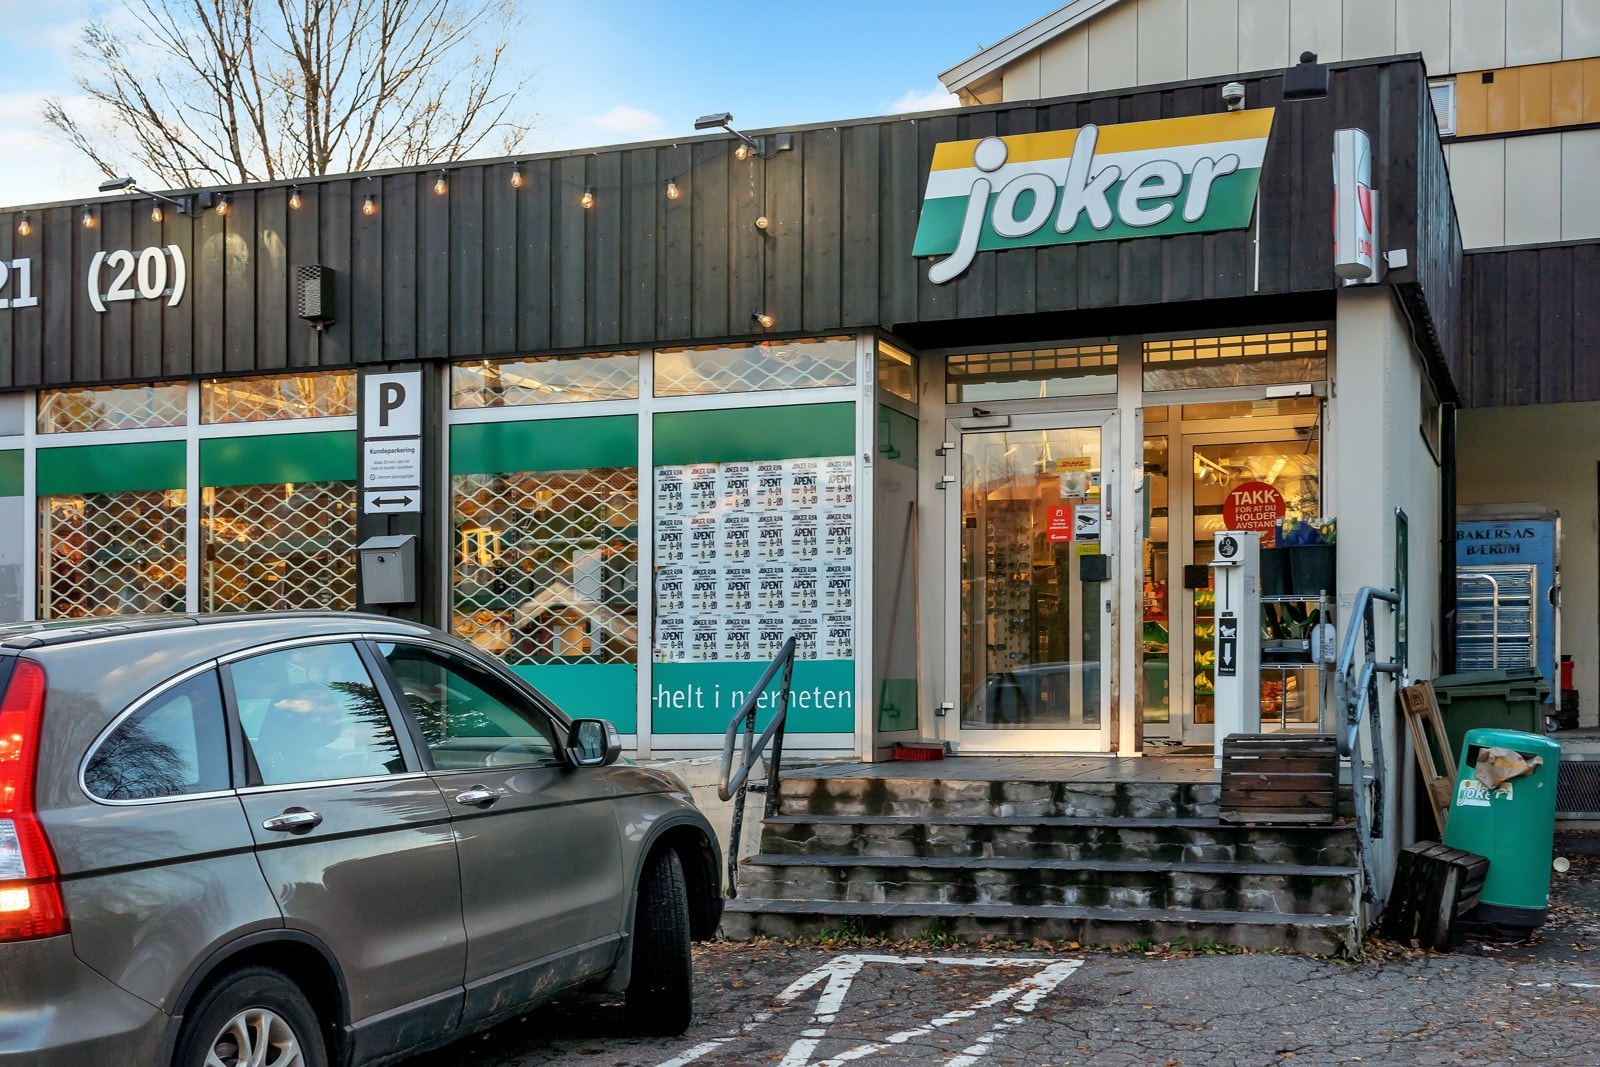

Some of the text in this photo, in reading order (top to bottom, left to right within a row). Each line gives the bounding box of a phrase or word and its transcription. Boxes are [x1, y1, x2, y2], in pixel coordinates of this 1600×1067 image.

[928, 123, 1239, 284] joker
[88, 245, 186, 312] (20)
[380, 382, 406, 426] P
[1236, 512, 1276, 521] HOLDER
[1236, 520, 1276, 529] AVSTAND
[715, 684, 719, 708] i
